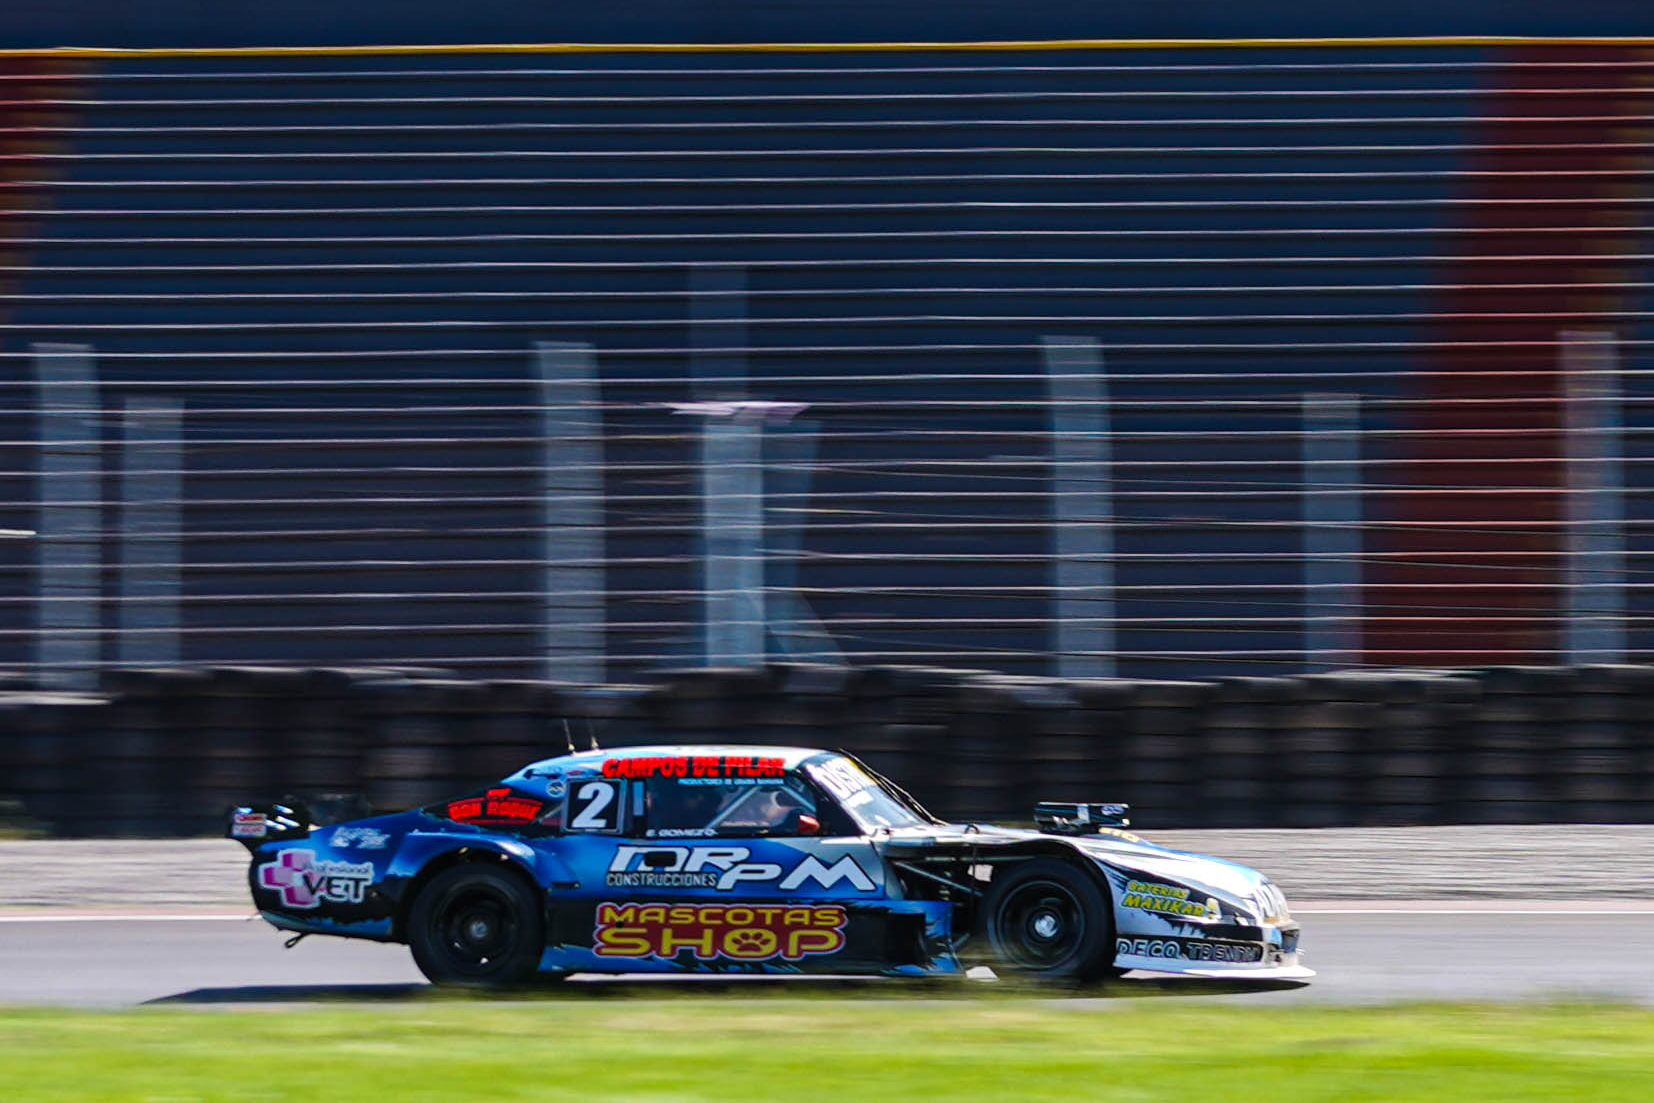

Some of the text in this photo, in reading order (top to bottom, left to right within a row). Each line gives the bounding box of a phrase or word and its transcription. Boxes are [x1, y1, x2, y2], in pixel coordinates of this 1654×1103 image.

[602, 756, 688, 778] CAMPOS
[692, 756, 720, 777] DE
[571, 782, 615, 829] 2
[302, 874, 369, 899] VET
[607, 873, 717, 887] CONSTRUCCIONES
[603, 907, 841, 926] MASCOTAS
[601, 927, 838, 957] SHOP
[1117, 938, 1181, 959] DECO
